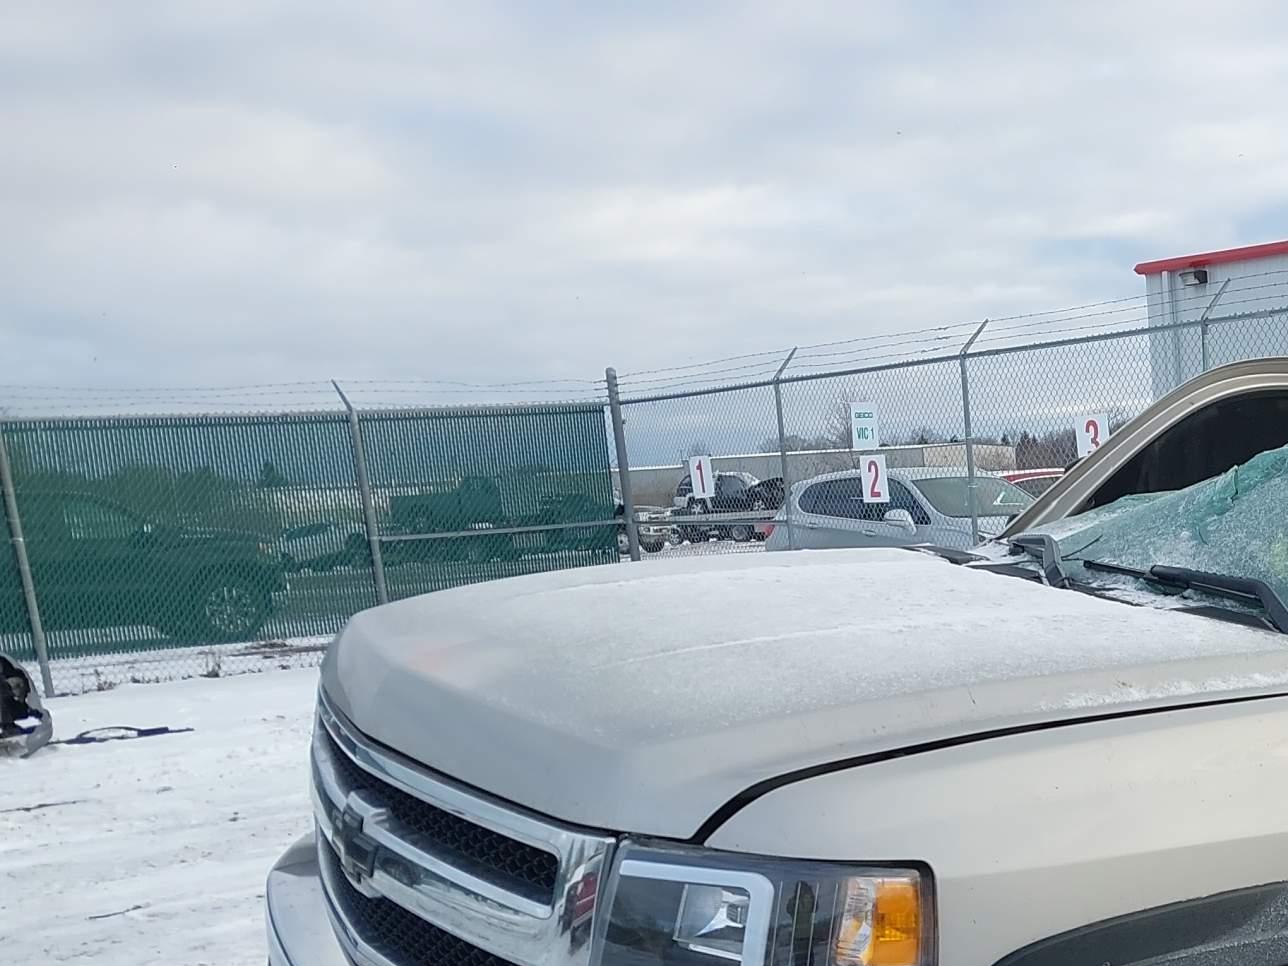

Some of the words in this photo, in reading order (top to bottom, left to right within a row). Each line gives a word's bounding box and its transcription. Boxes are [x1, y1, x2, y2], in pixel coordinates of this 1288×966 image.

[856, 426, 869, 440] VIC
[1085, 419, 1100, 452] 3
[695, 459, 706, 494] 1
[867, 460, 882, 498] 2
